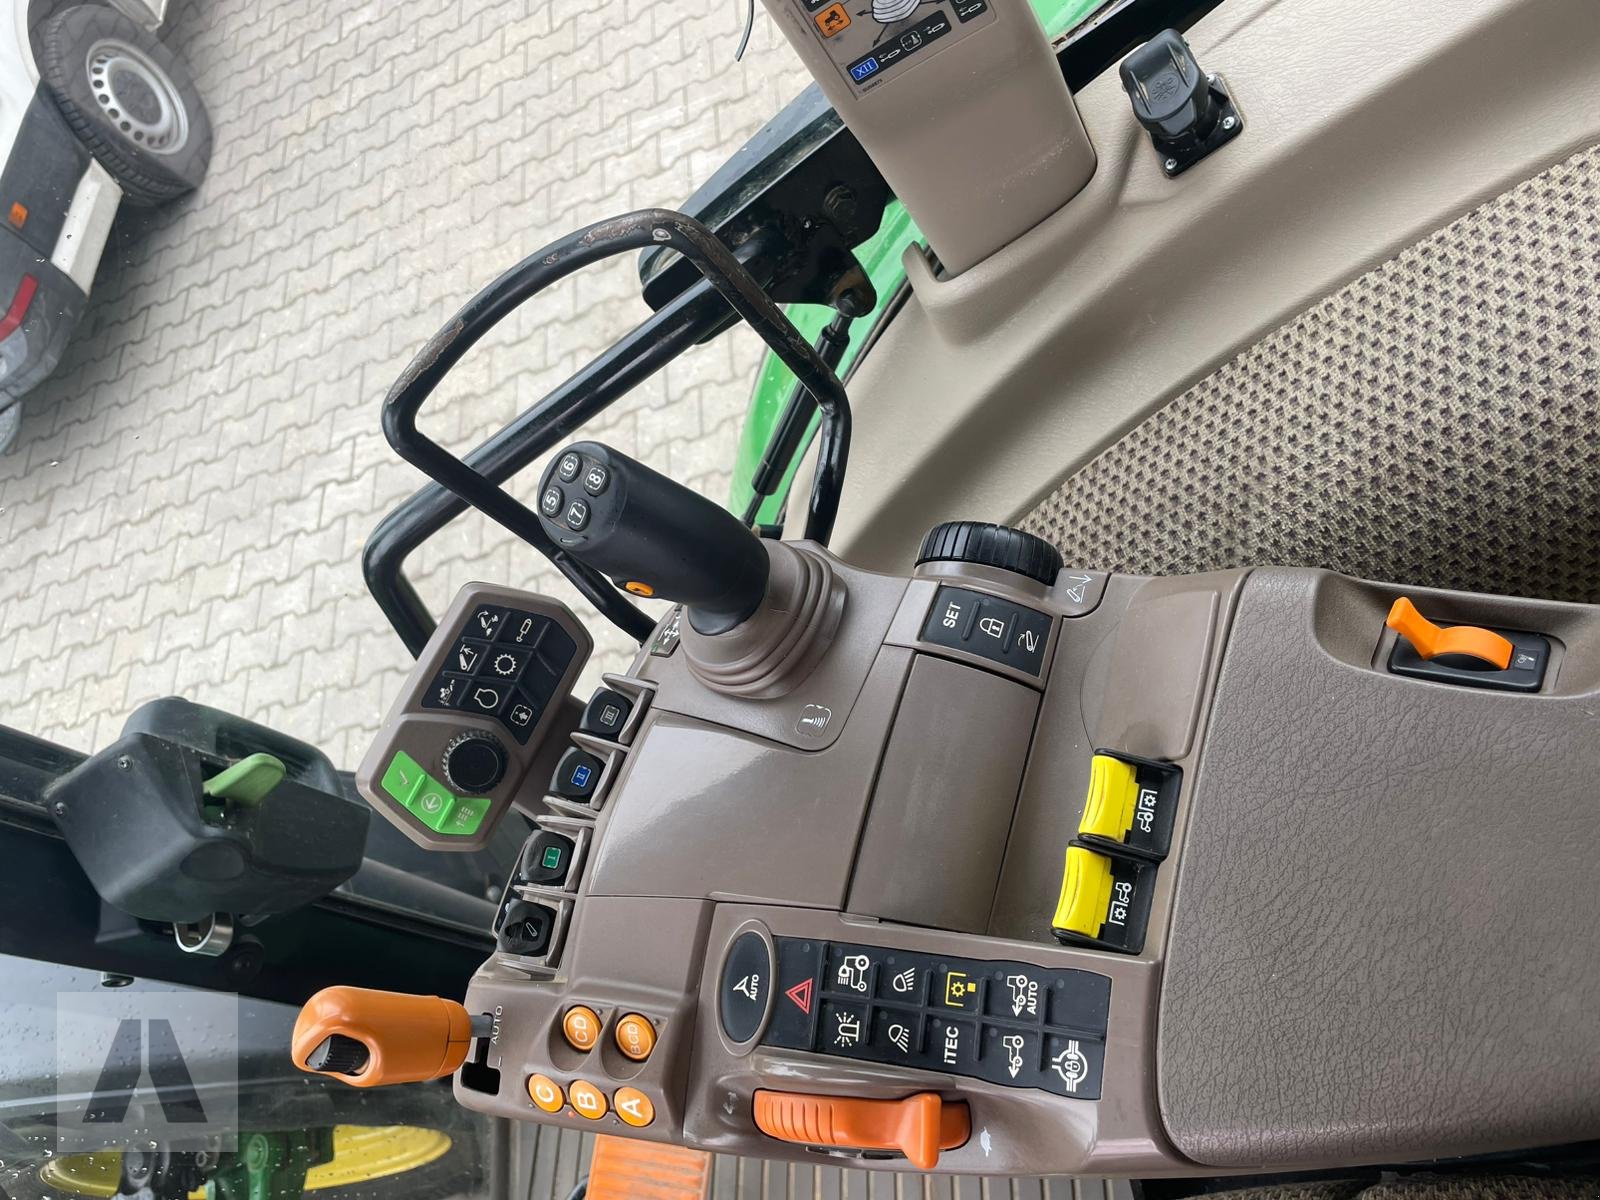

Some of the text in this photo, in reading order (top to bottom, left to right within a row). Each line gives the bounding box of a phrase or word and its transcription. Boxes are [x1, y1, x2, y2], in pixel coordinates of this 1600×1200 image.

[856, 62, 873, 77] XII
[564, 461, 574, 471] 6
[589, 473, 601, 485] 8
[546, 495, 556, 506] 5
[570, 507, 582, 519] 7
[943, 601, 961, 628] SET
[749, 974, 759, 1001] AUTO
[1027, 980, 1038, 1015] AUTO
[490, 1005, 503, 1045] AUTO
[574, 1015, 588, 1043] CD
[943, 1026, 959, 1064] iTEC
[535, 1085, 555, 1103] C
[577, 1092, 597, 1111] B
[621, 1098, 642, 1118] A
